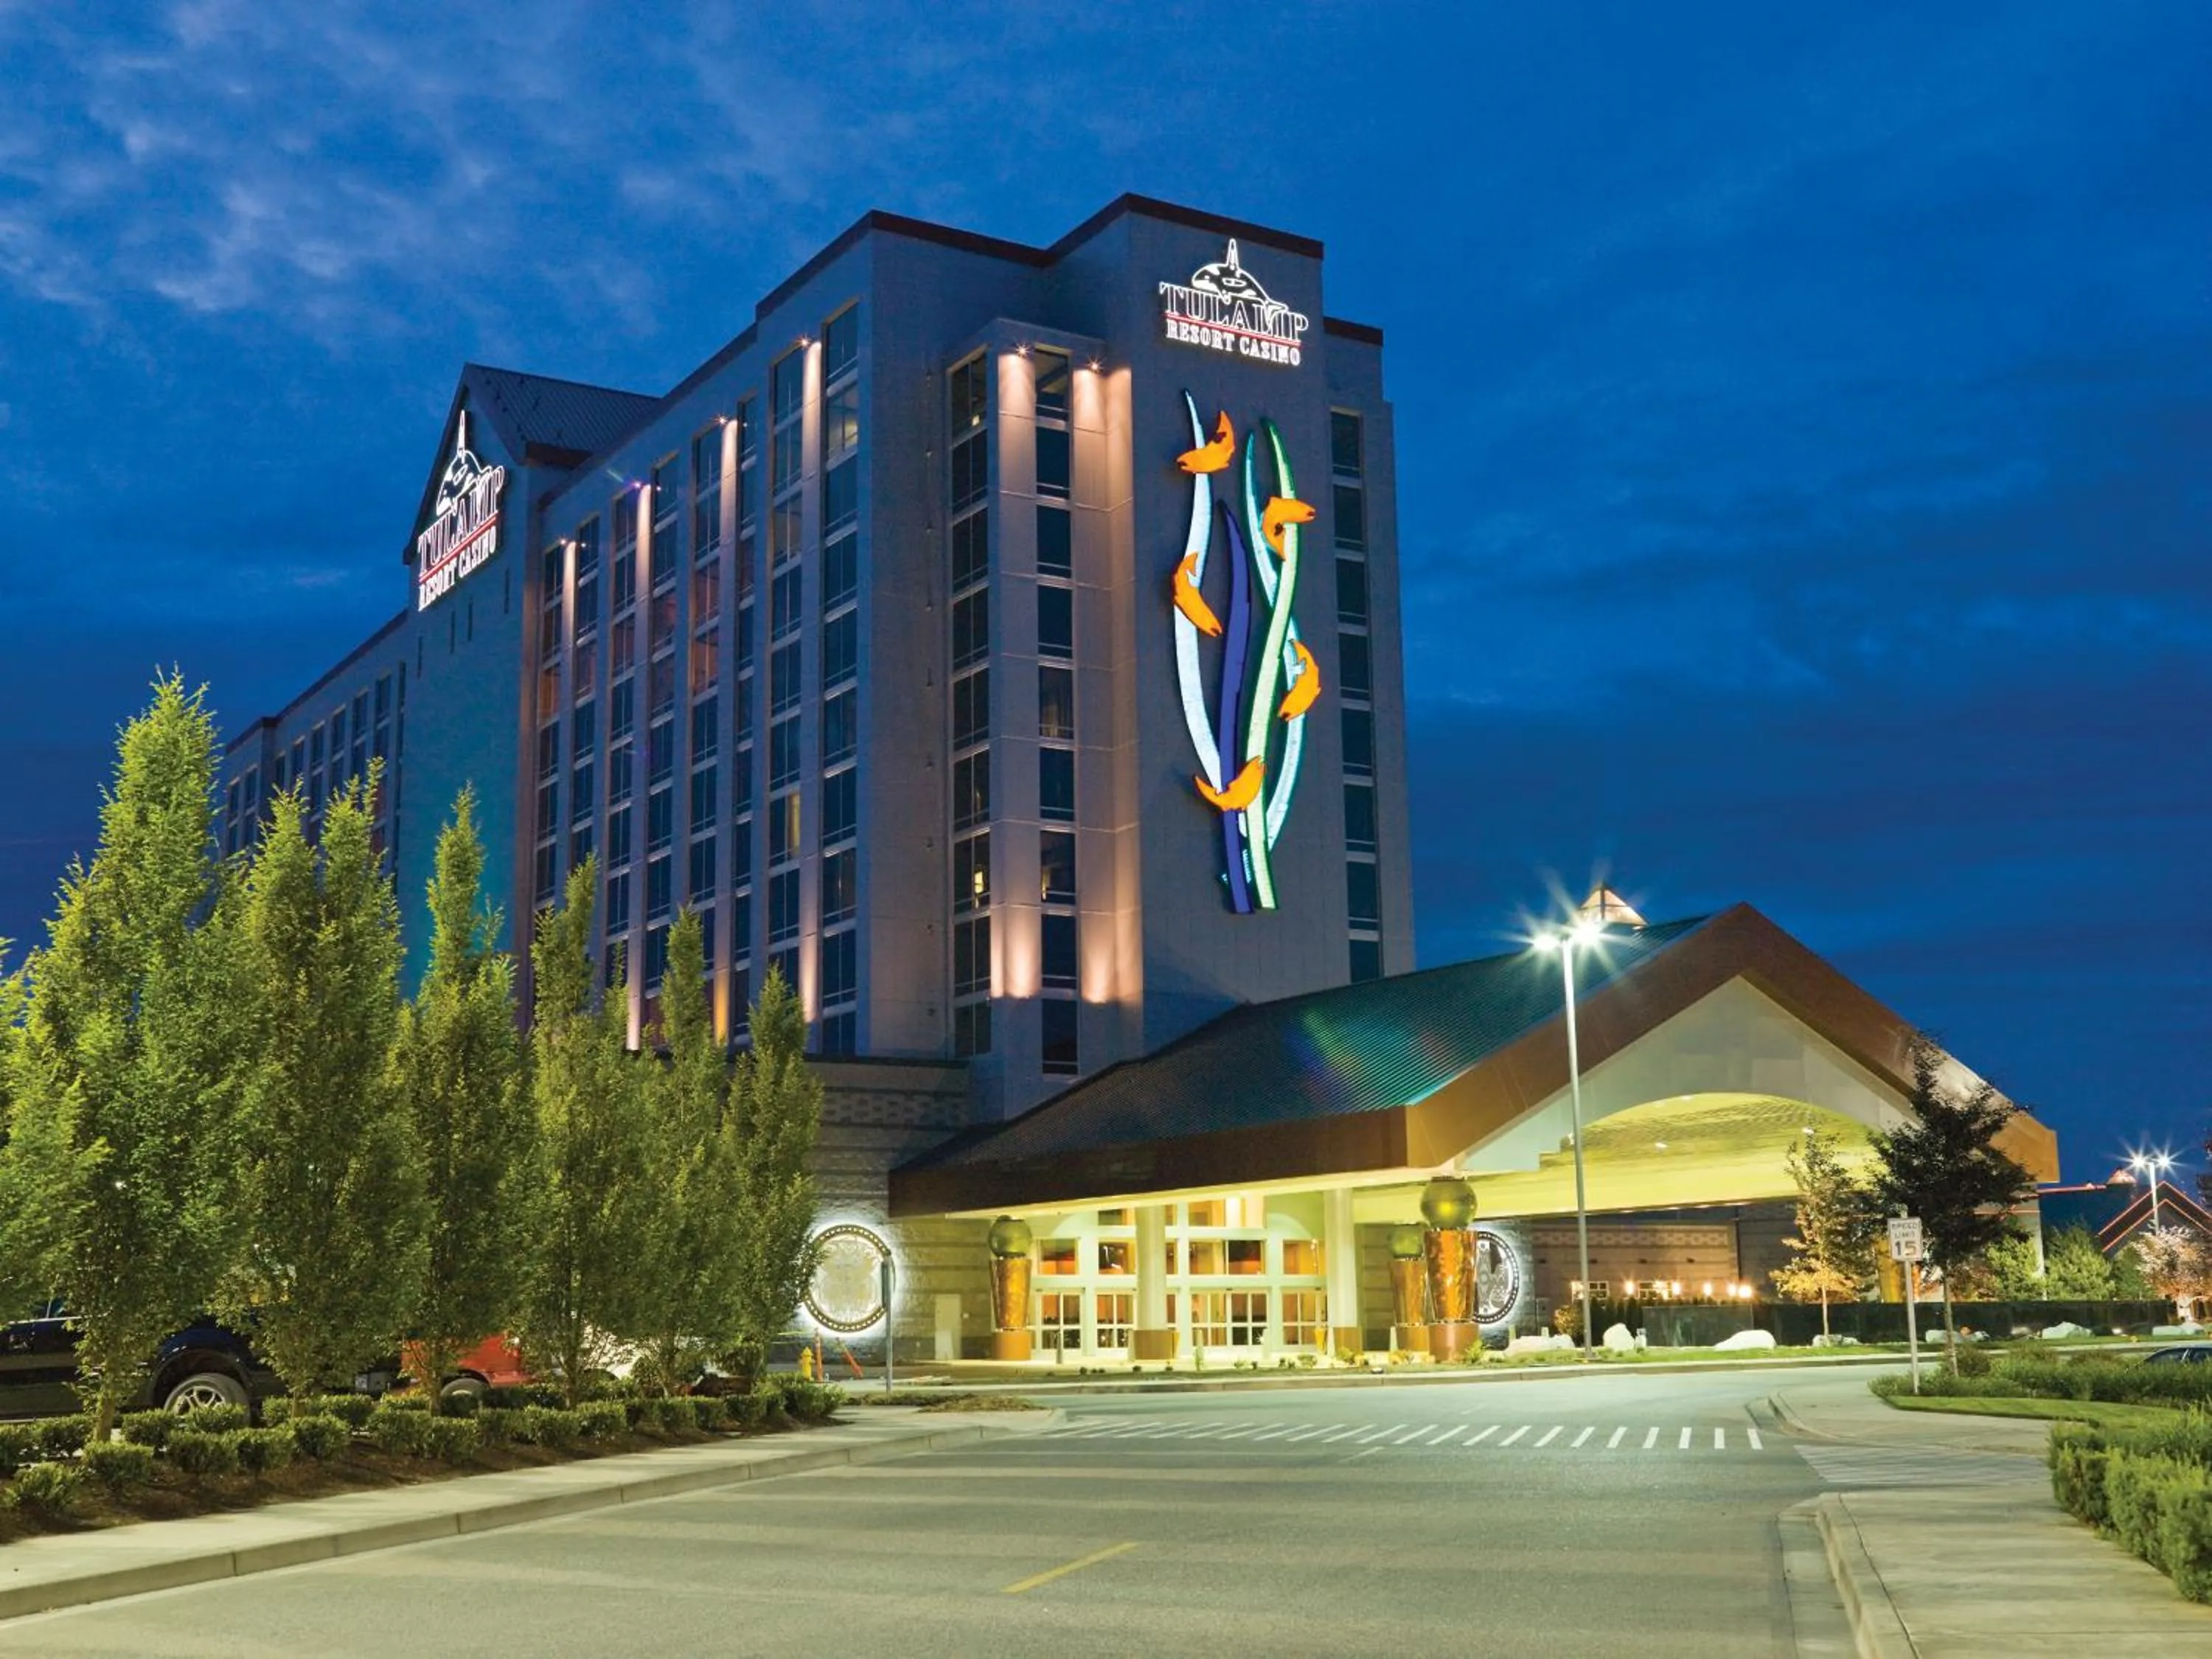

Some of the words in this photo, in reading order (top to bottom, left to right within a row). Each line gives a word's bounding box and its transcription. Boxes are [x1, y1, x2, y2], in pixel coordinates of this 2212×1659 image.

[1166, 318, 1234, 352] RESORT
[1239, 336, 1301, 366] CASINO
[458, 526, 497, 579] CASINO
[1895, 1240, 1917, 1256] 15
